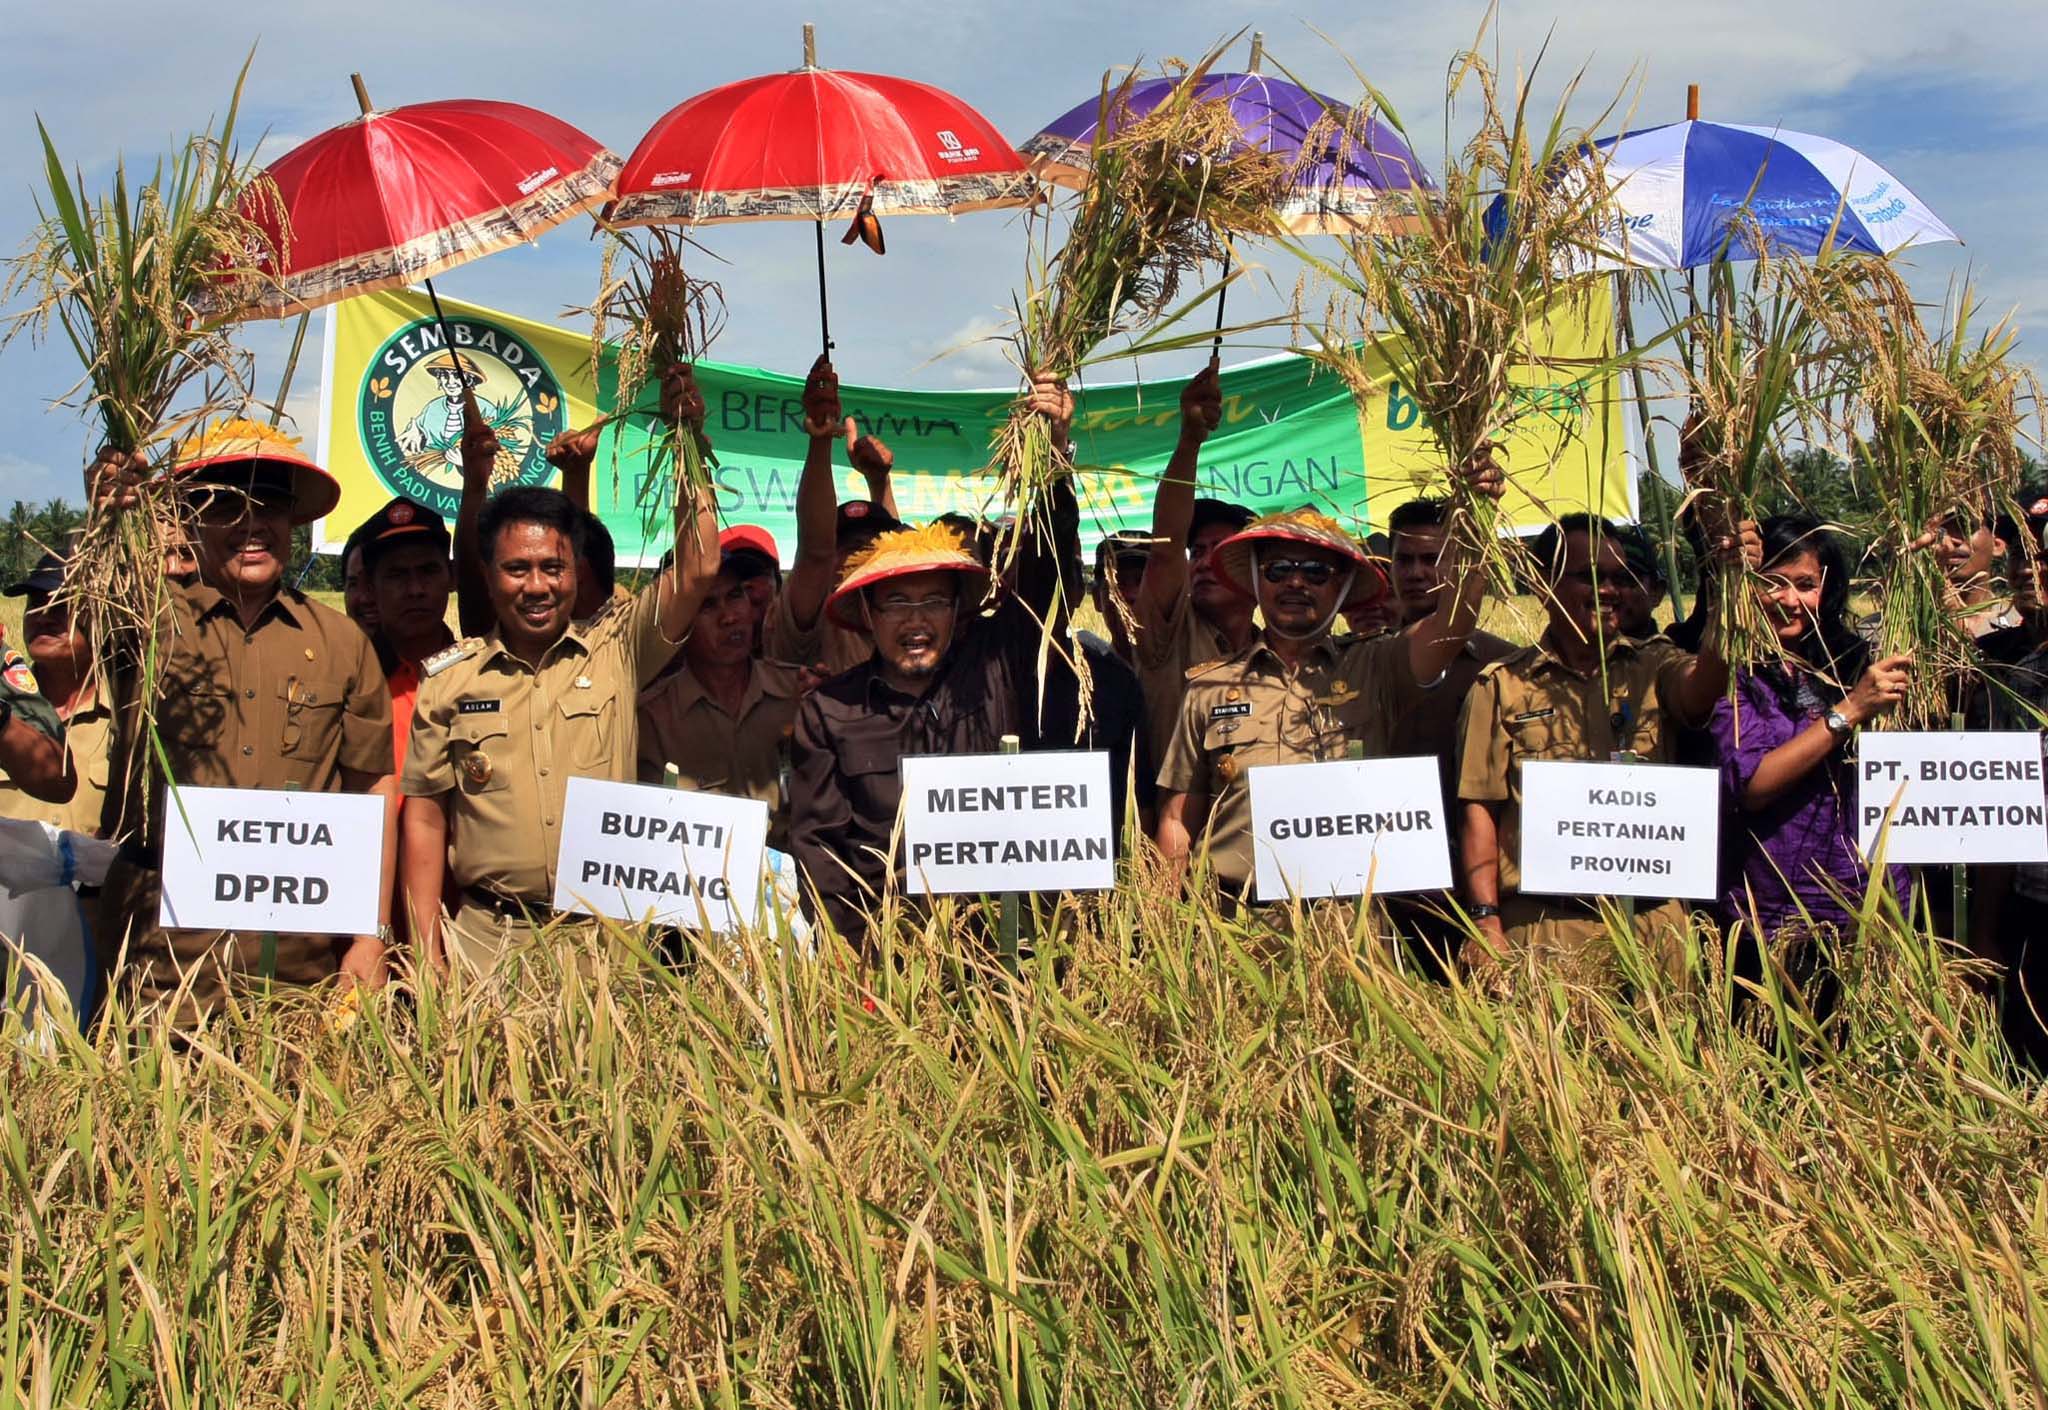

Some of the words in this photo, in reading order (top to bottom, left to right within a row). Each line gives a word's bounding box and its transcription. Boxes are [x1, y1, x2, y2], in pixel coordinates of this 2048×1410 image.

[384, 323, 542, 388] SEMBADA
[721, 391, 961, 436] BERAMA
[369, 410, 397, 466] BENIH
[392, 467, 431, 501] PADI
[1156, 455, 1340, 502] NGAN
[1865, 761, 1909, 782] PT.
[1920, 760, 2040, 781] BIOGENE
[927, 784, 1088, 813] MENTERI
[1589, 790, 1656, 807] KADIS
[601, 812, 723, 848] BUPATI
[1270, 810, 1432, 840] GUBERNUR
[1864, 805, 2043, 826] PLANTATION
[217, 819, 333, 846] KETUA
[1558, 821, 1685, 841] PERTANIAN
[912, 838, 1107, 866] PERTANIAN
[1571, 856, 1671, 874] PROVINSI
[215, 873, 329, 905] DPRD
[581, 860, 730, 901] PINRANG
